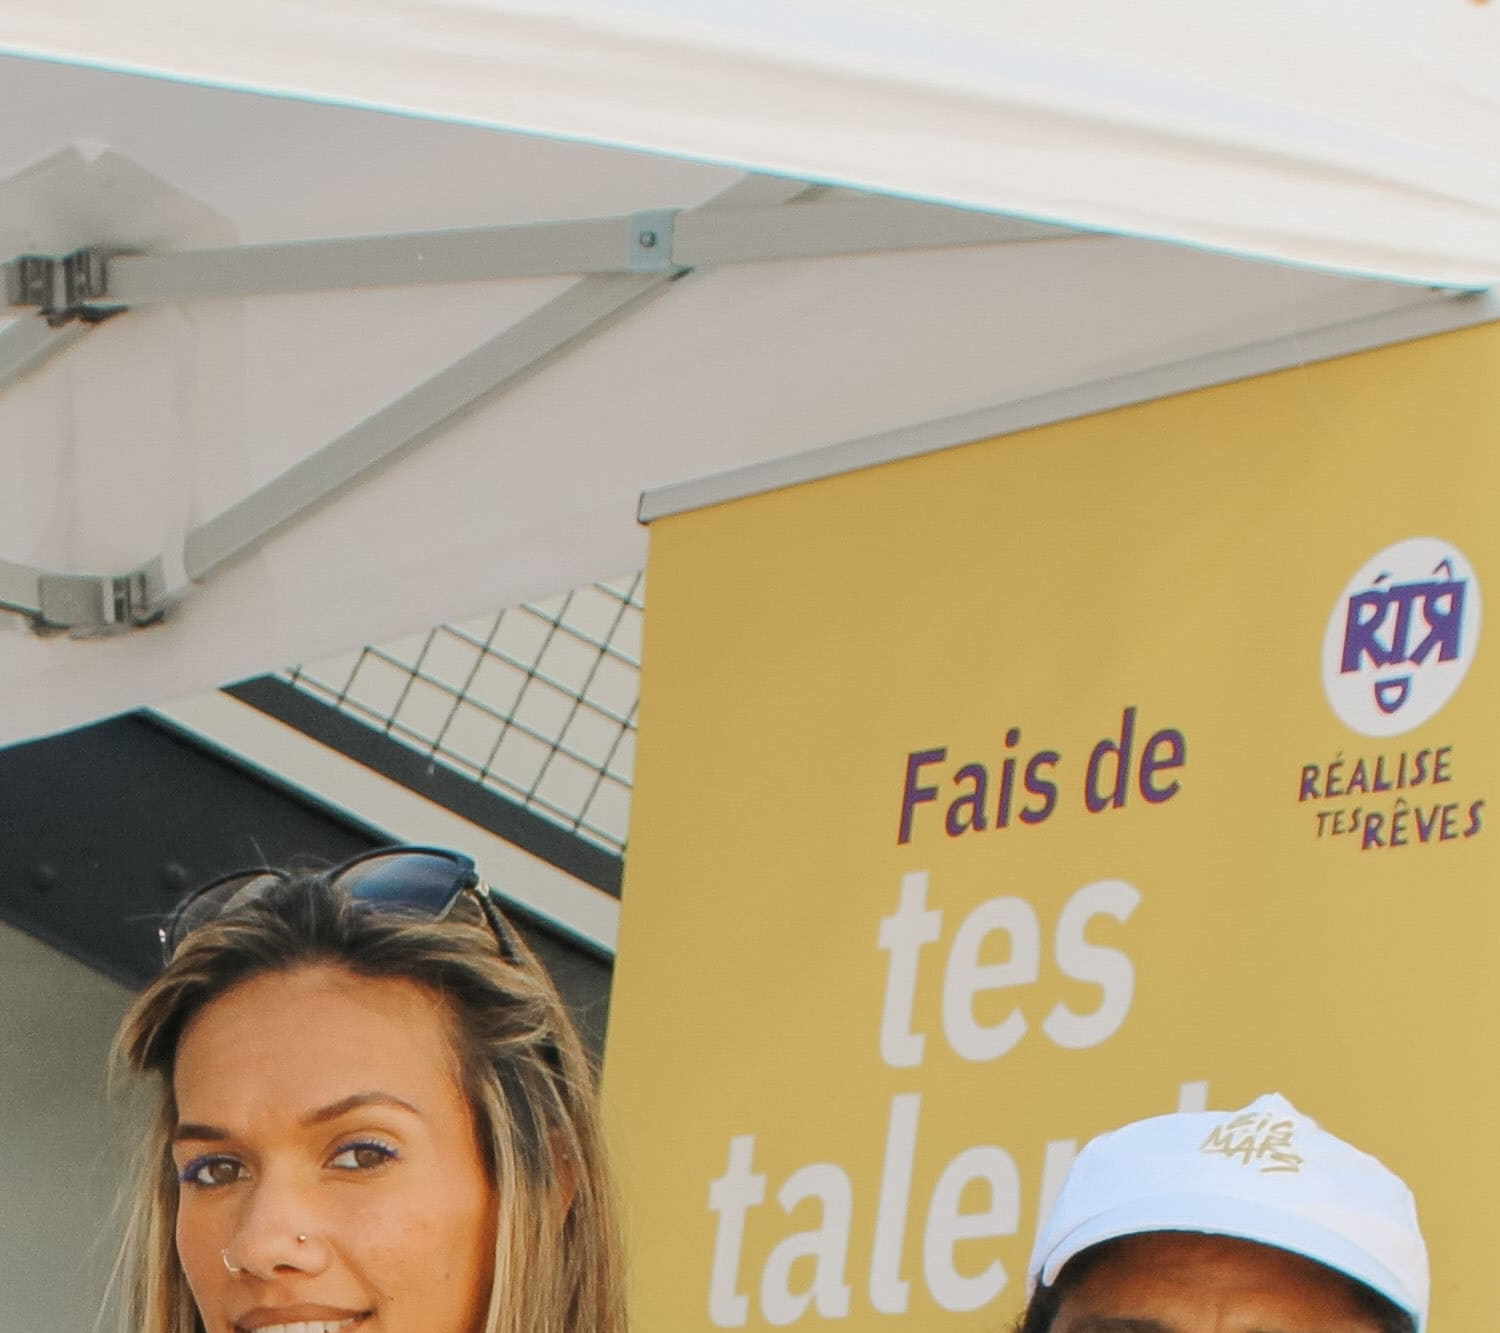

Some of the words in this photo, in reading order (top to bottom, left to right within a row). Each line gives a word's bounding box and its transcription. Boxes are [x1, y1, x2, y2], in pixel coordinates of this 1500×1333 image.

[897, 725, 1062, 846] Fais
[1084, 706, 1187, 813] de
[1299, 747, 1452, 802] RÉALISE
[1317, 807, 1361, 838] TES
[1362, 798, 1486, 851] RÊVES
[878, 870, 1143, 1068] tes
[708, 1081, 1209, 1328] tale
